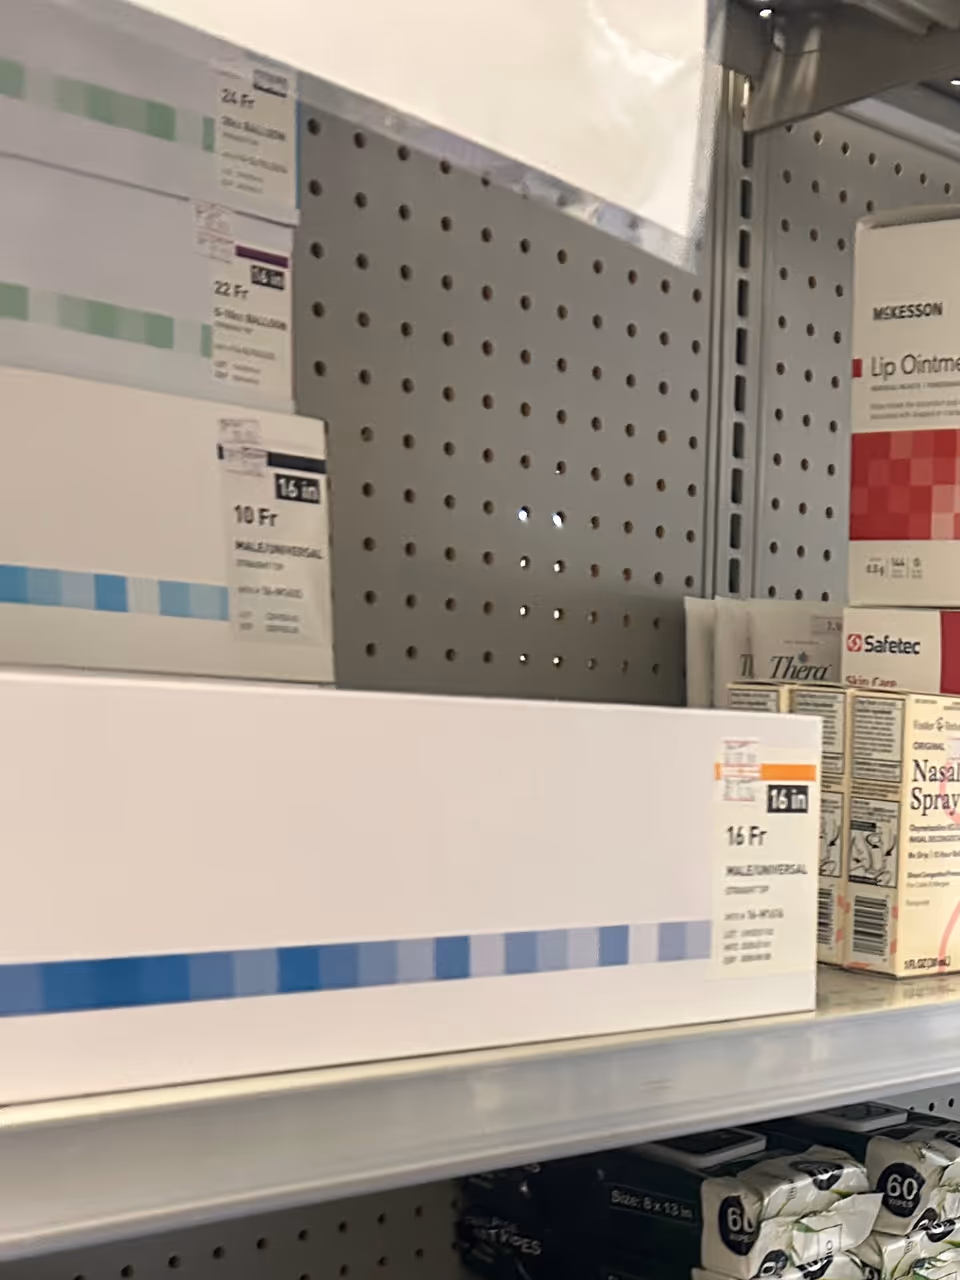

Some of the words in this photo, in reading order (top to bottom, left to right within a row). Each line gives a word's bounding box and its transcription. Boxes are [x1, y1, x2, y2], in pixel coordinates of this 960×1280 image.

[870, 355, 896, 381] Lip
[277, 477, 299, 498] 16
[301, 480, 320, 502] in
[234, 504, 254, 524] 10
[258, 508, 278, 527] Fr
[863, 633, 920, 656] Safetec
[768, 653, 833, 682] Thera
[912, 741, 945, 751] ORIGINAL
[911, 758, 960, 783] Nasal
[769, 787, 789, 810] 16
[790, 787, 808, 810] in
[910, 786, 960, 817] Spray
[726, 825, 745, 846] 16
[748, 825, 768, 846] Fr
[887, 1173, 919, 1201] 60
[610, 1188, 642, 1205] Size:
[679, 1208, 693, 1219] in
